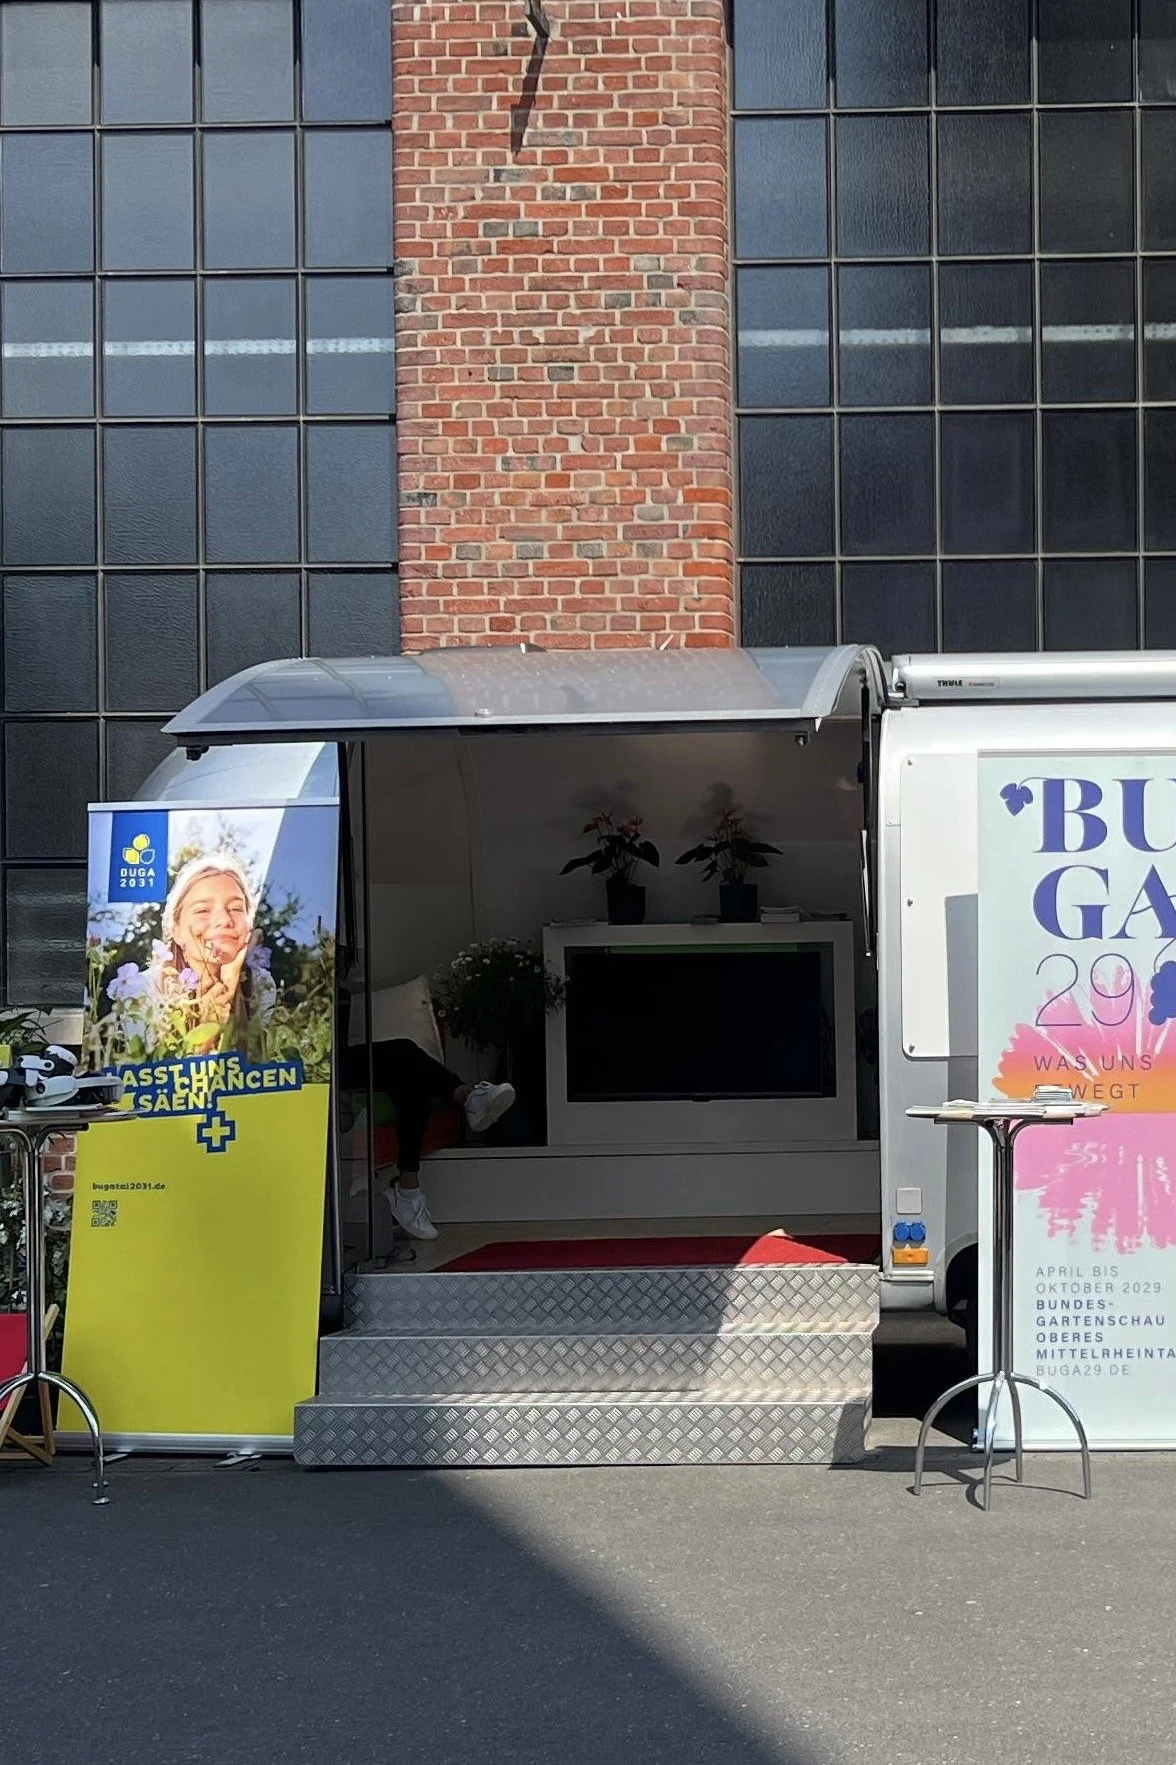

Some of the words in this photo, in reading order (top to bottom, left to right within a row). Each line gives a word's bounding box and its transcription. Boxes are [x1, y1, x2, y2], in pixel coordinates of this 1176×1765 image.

[120, 868, 155, 877] BUGA
[119, 878, 154, 888] 2031
[1035, 953, 1135, 1026] 29
[1034, 1055, 1087, 1071] WAS
[1101, 1054, 1152, 1070] UNS
[106, 1064, 183, 1088] ASST
[190, 1057, 241, 1078] UNS
[174, 1067, 297, 1096] CHANCEN
[92, 1182, 166, 1191] bugatal2031.de
[1035, 1266, 1084, 1277] APRIL
[1092, 1266, 1119, 1277] BIS
[1035, 1282, 1114, 1294] OKTOBER
[1122, 1282, 1162, 1294] 2029
[1036, 1299, 1114, 1310] BUNDES-
[1036, 1315, 1165, 1326] GARTENSCHAU
[1036, 1332, 1103, 1343] OBERES
[1036, 1364, 1131, 1376] BUGA29.DE
